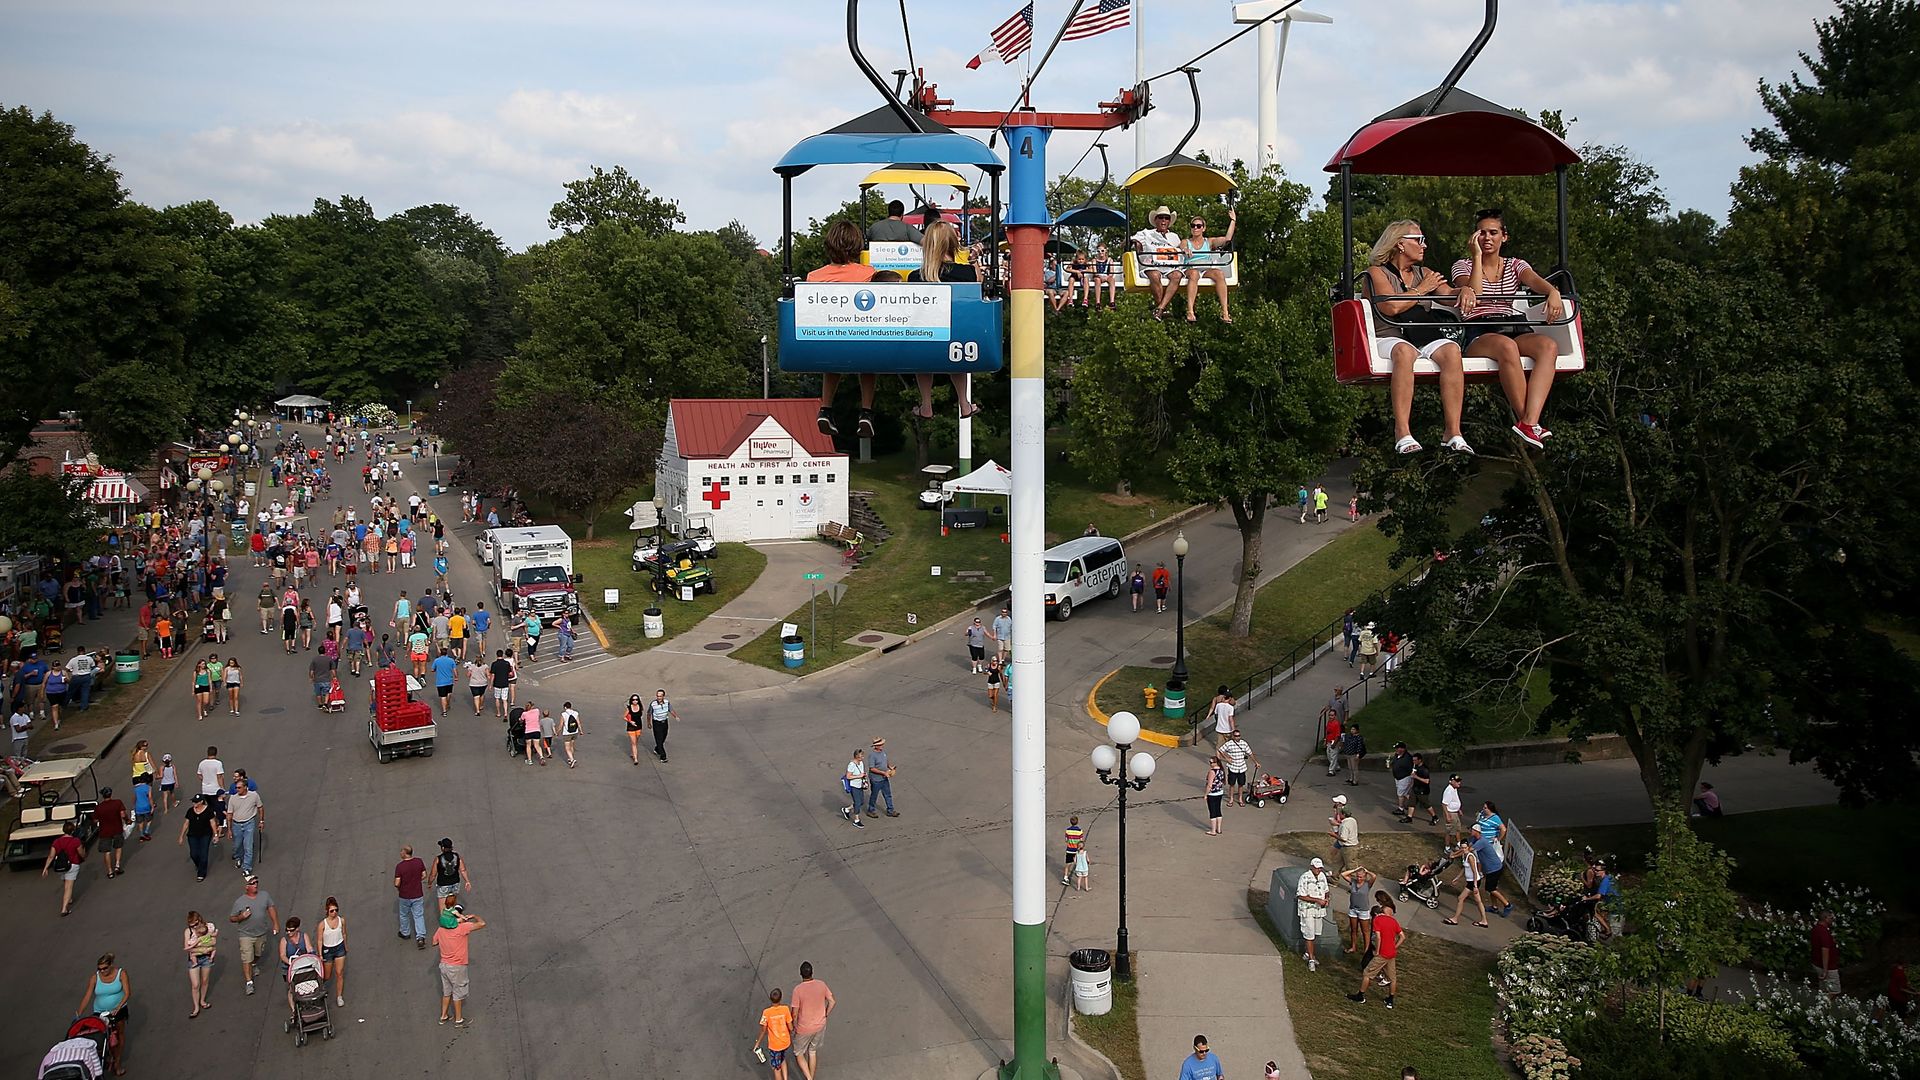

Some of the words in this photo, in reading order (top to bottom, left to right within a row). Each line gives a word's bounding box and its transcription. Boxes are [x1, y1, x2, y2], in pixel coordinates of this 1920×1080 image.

[1020, 136, 1033, 159] 4
[876, 246, 896, 254] sleep
[807, 292, 850, 308] sleep
[880, 292, 936, 304] number
[827, 314, 853, 322] know
[854, 314, 883, 322] better
[905, 329, 934, 338] Building
[948, 341, 979, 362] 69
[1086, 560, 1127, 588] catering
